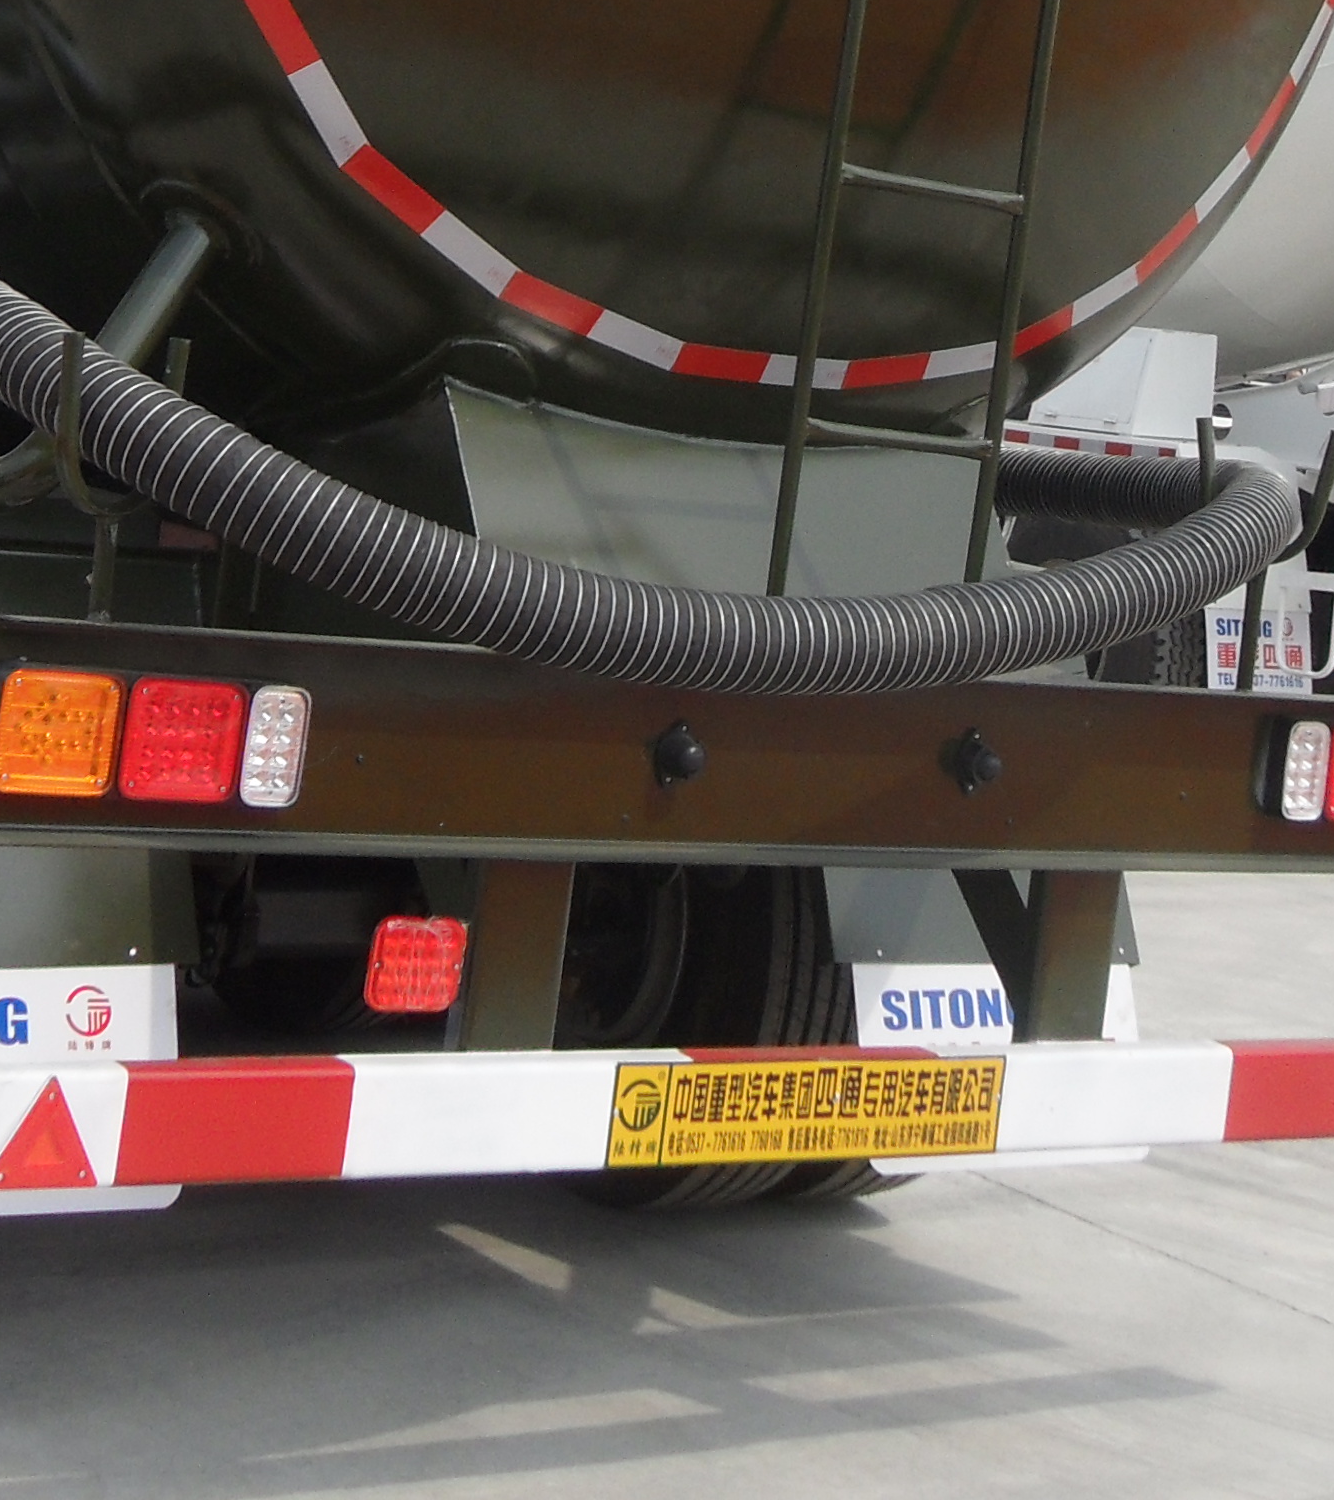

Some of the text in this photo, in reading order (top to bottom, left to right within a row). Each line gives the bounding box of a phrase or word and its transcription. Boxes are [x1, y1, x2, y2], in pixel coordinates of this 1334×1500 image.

[1216, 617, 1273, 638] SITG
[1217, 642, 1303, 670] 重四通
[881, 988, 1014, 1032] SITON
[672, 1065, 997, 1123] 中国重型汽车集团四通专用汽车有限公司
